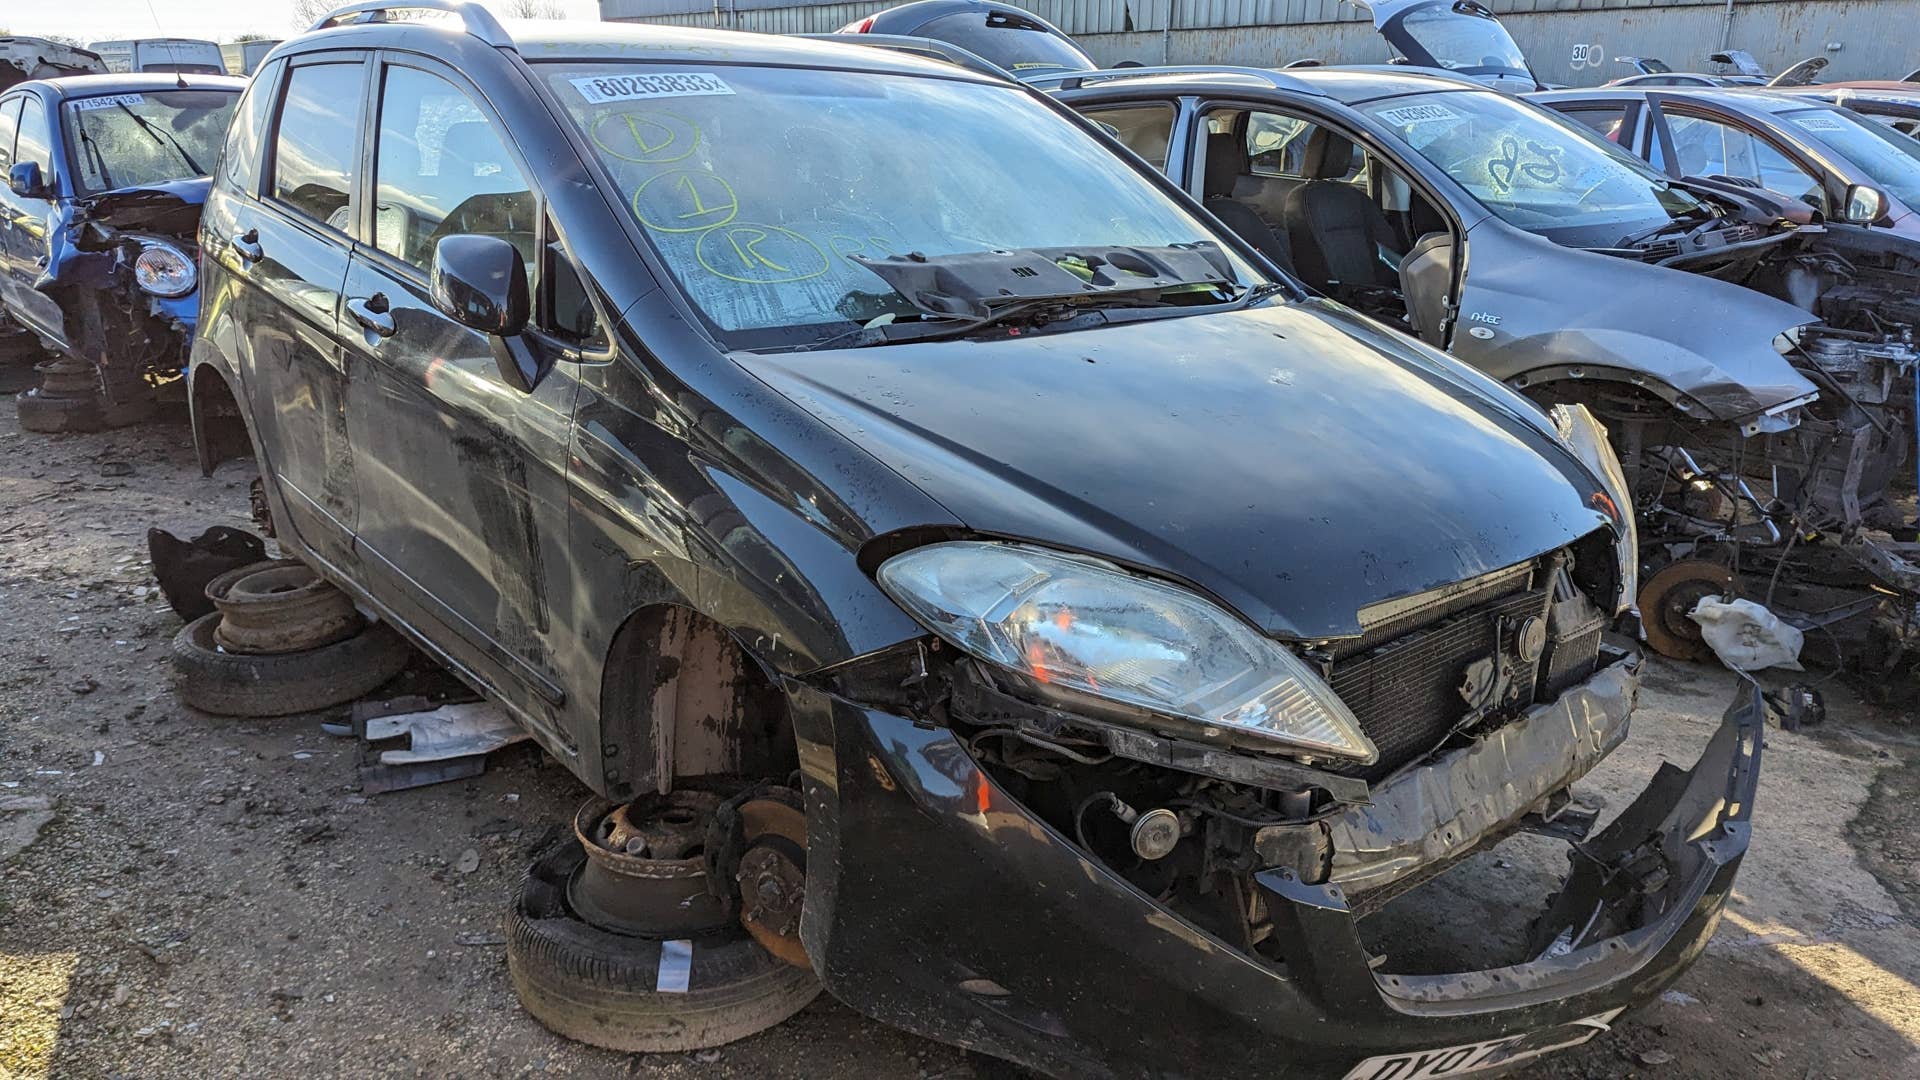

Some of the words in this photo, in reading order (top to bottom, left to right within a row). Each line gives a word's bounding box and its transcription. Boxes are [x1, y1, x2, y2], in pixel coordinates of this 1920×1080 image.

[1573, 46, 1588, 60] 30
[620, 113, 675, 154] D
[677, 175, 736, 219] 1
[725, 228, 790, 272] R
[1471, 312, 1501, 325] n-tec
